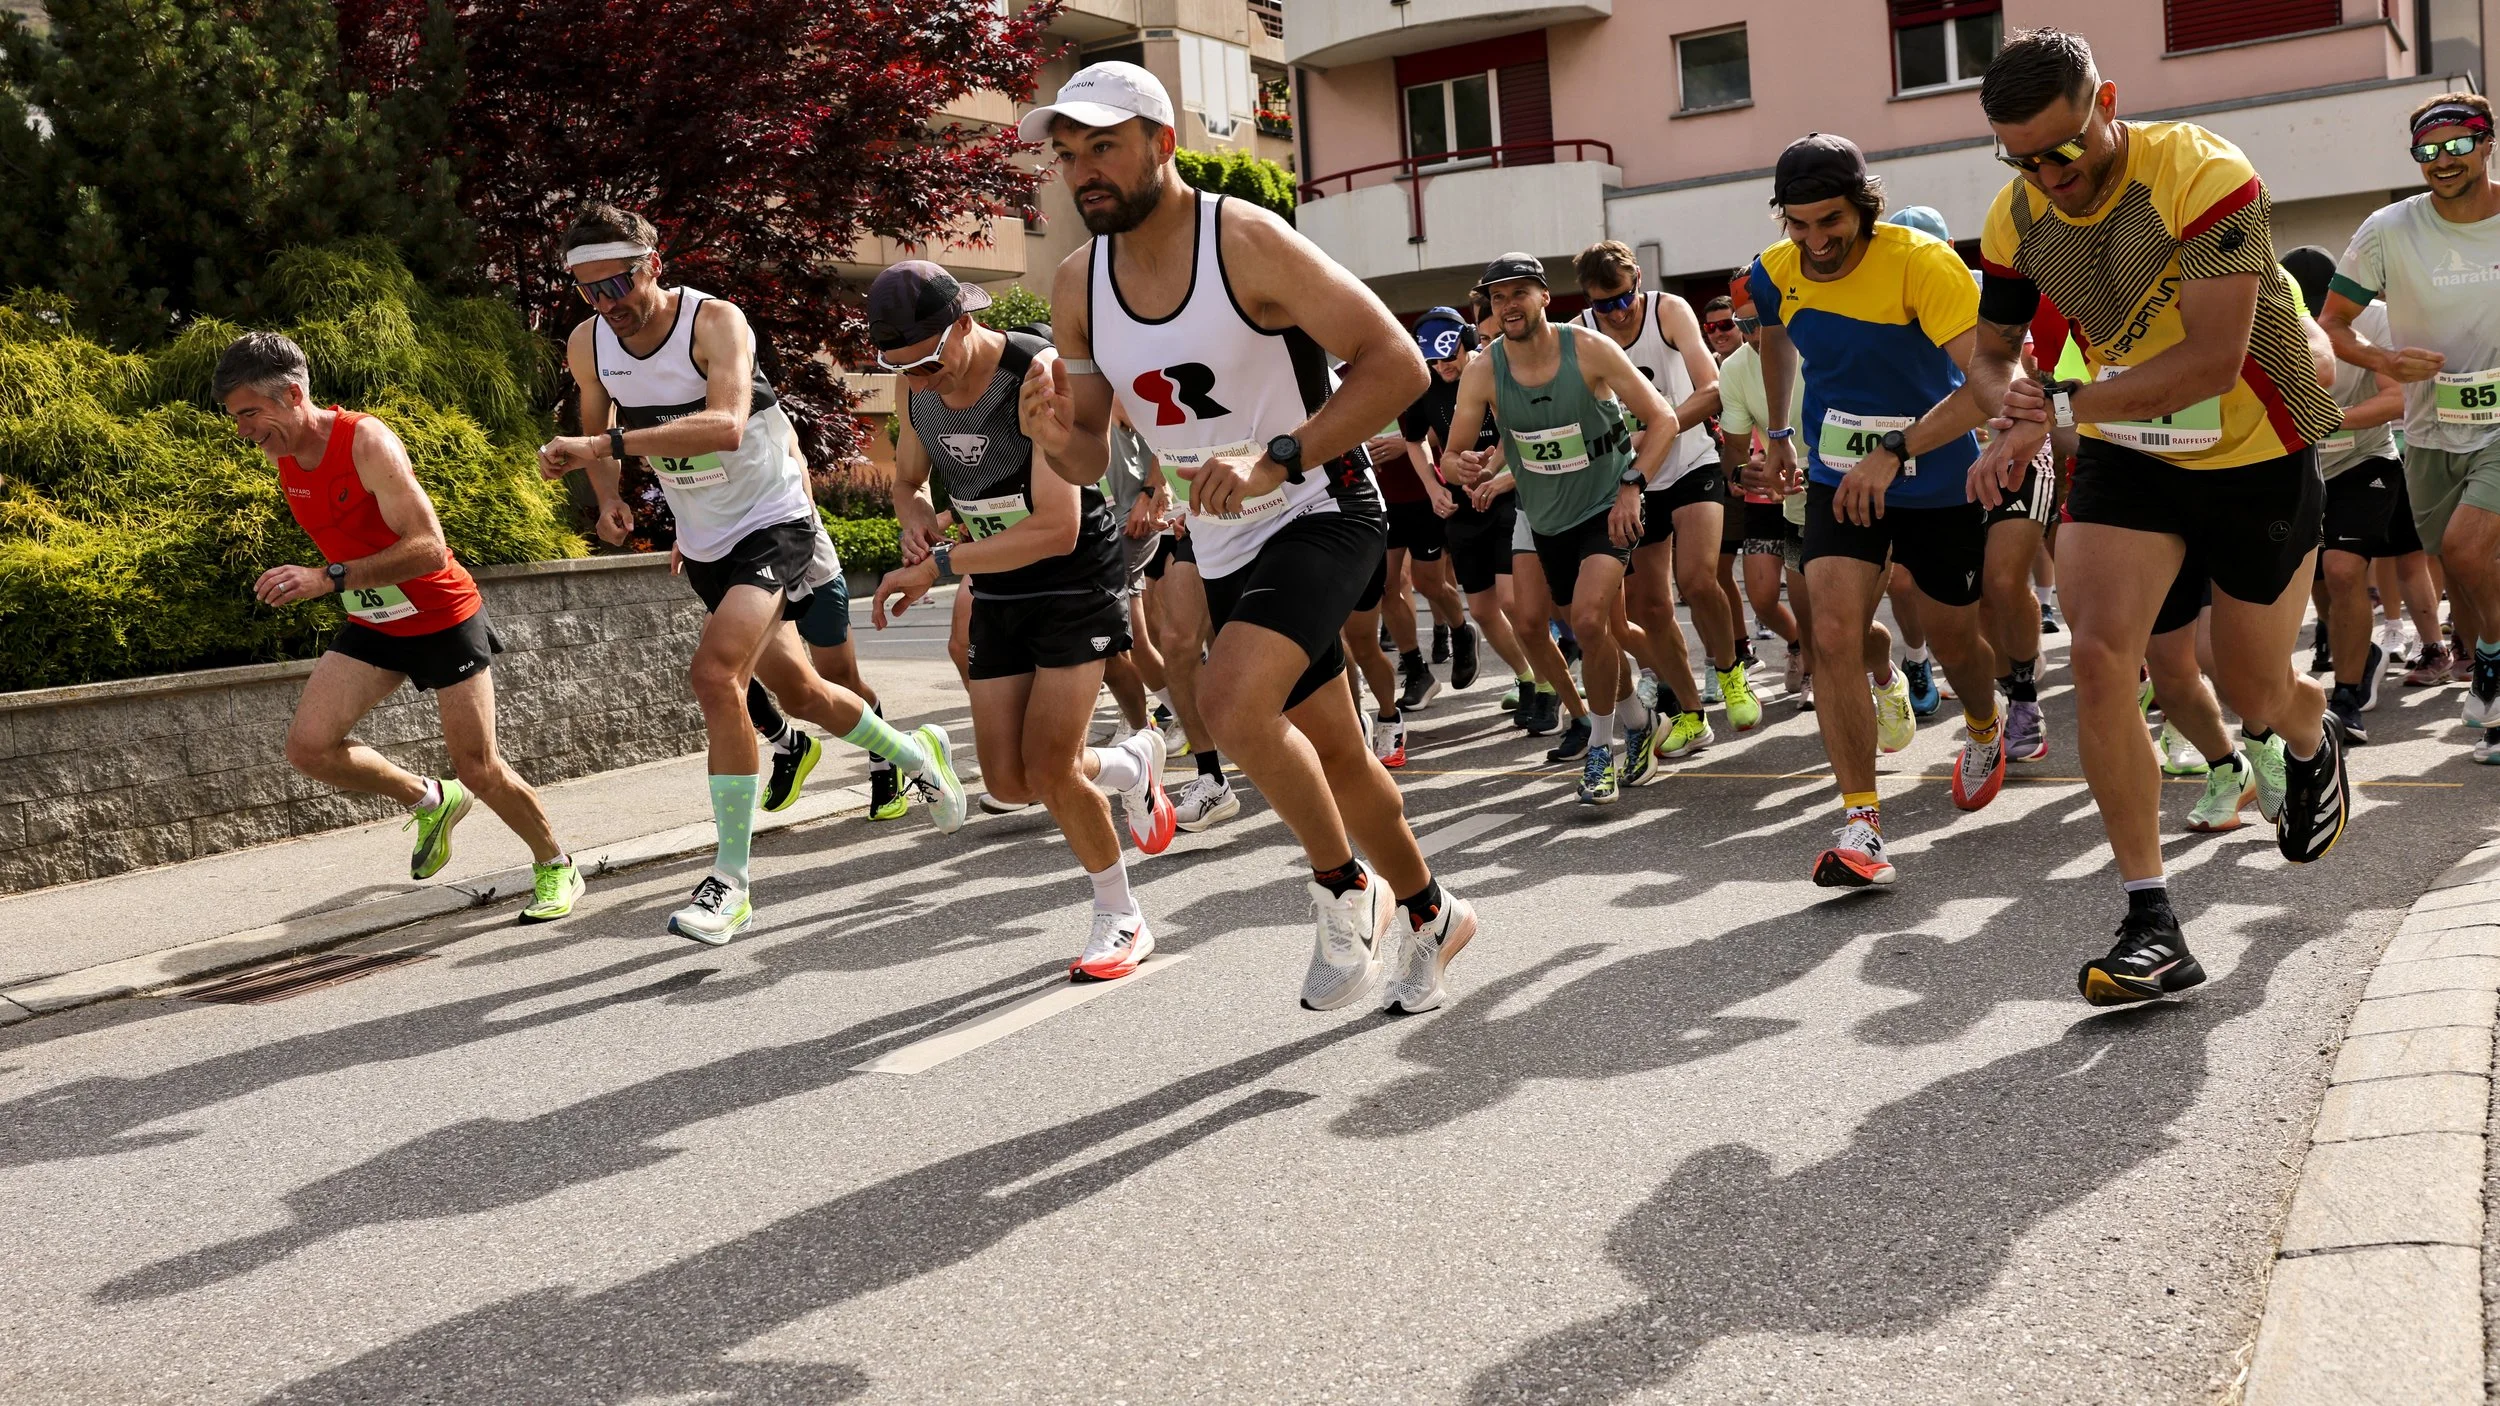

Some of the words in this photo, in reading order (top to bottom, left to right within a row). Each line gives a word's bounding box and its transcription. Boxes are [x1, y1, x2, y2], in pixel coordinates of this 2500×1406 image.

[2459, 384, 2497, 408] 85
[1842, 417, 1862, 427] gampel
[1875, 419, 1907, 429] lonzalauf
[1846, 432, 1881, 456] 40
[2172, 436, 2219, 446] RAIFFEISEN
[1532, 441, 1563, 460] 23
[661, 457, 695, 471] 52
[1177, 453, 1200, 463] gampel
[1823, 459, 1854, 469] RAIFFEISEN
[694, 472, 724, 482] RAIFFEISEN
[987, 498, 1017, 510] lonzalauf
[1242, 497, 1284, 517] RAIFFEISEN
[972, 516, 1007, 539] 35
[353, 588, 385, 609] 26
[388, 605, 413, 616] RAIFFEISEN
